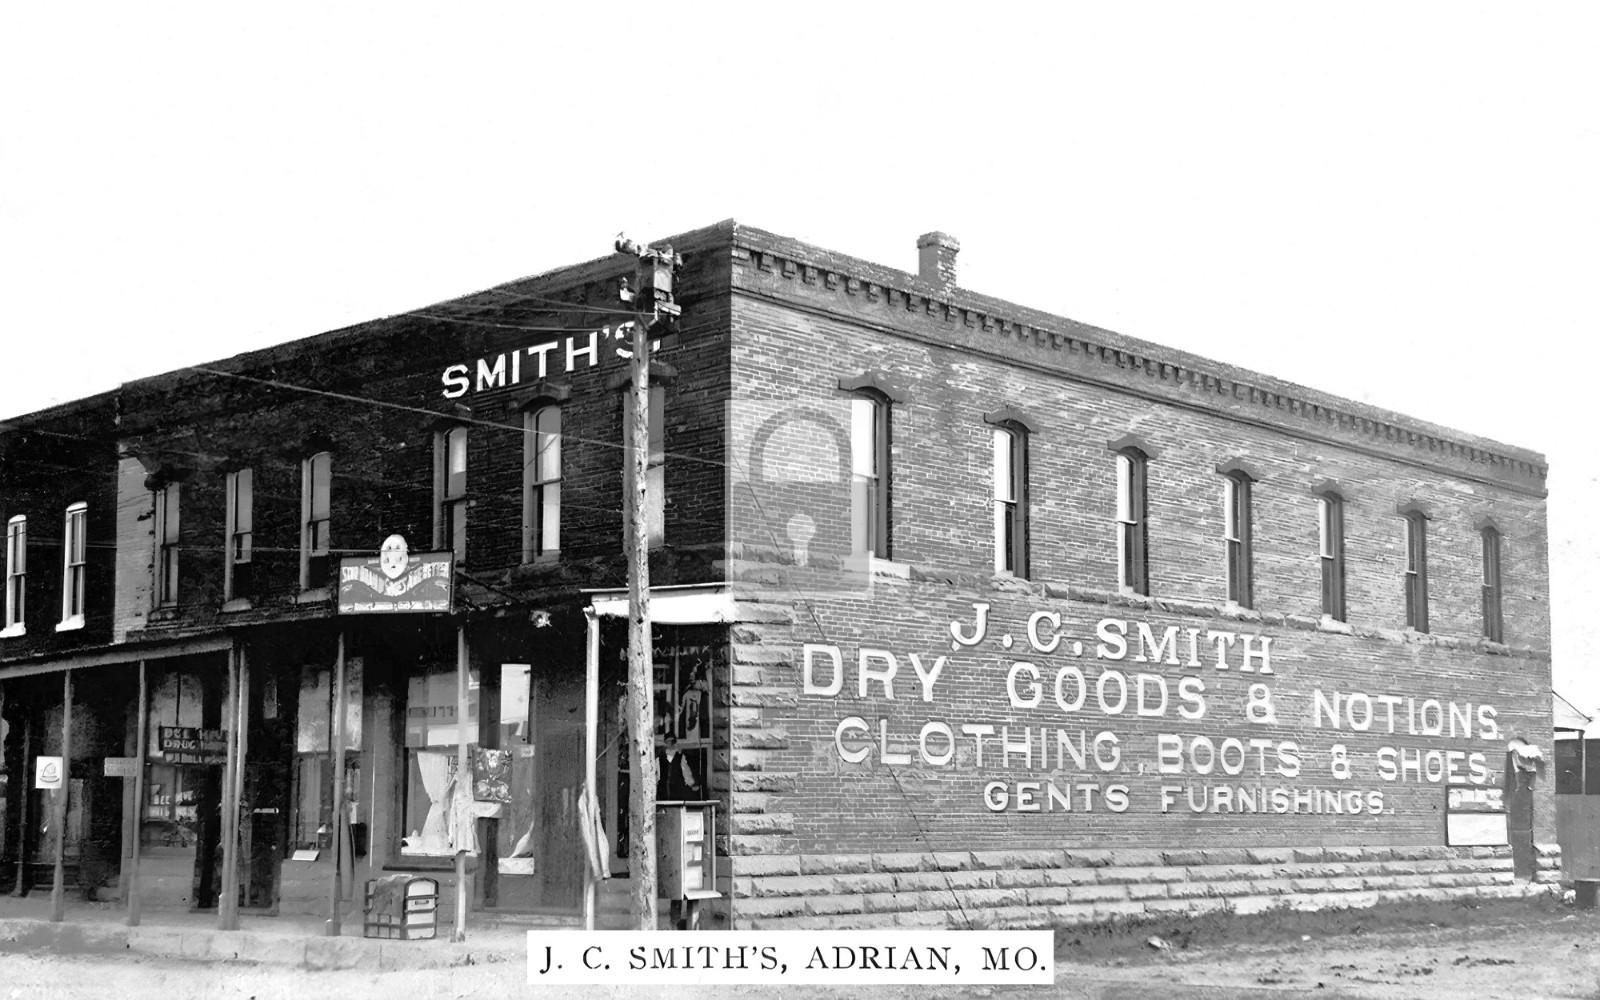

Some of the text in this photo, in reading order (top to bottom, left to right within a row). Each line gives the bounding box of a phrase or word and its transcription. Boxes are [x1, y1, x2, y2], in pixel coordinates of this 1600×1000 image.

[803, 643, 947, 702] DRY
[1006, 662, 1207, 721] GOODS
[1245, 682, 1276, 726] &
[1157, 733, 1302, 778] BOOTS
[1331, 743, 1352, 781] &
[984, 781, 1130, 813] GENTS
